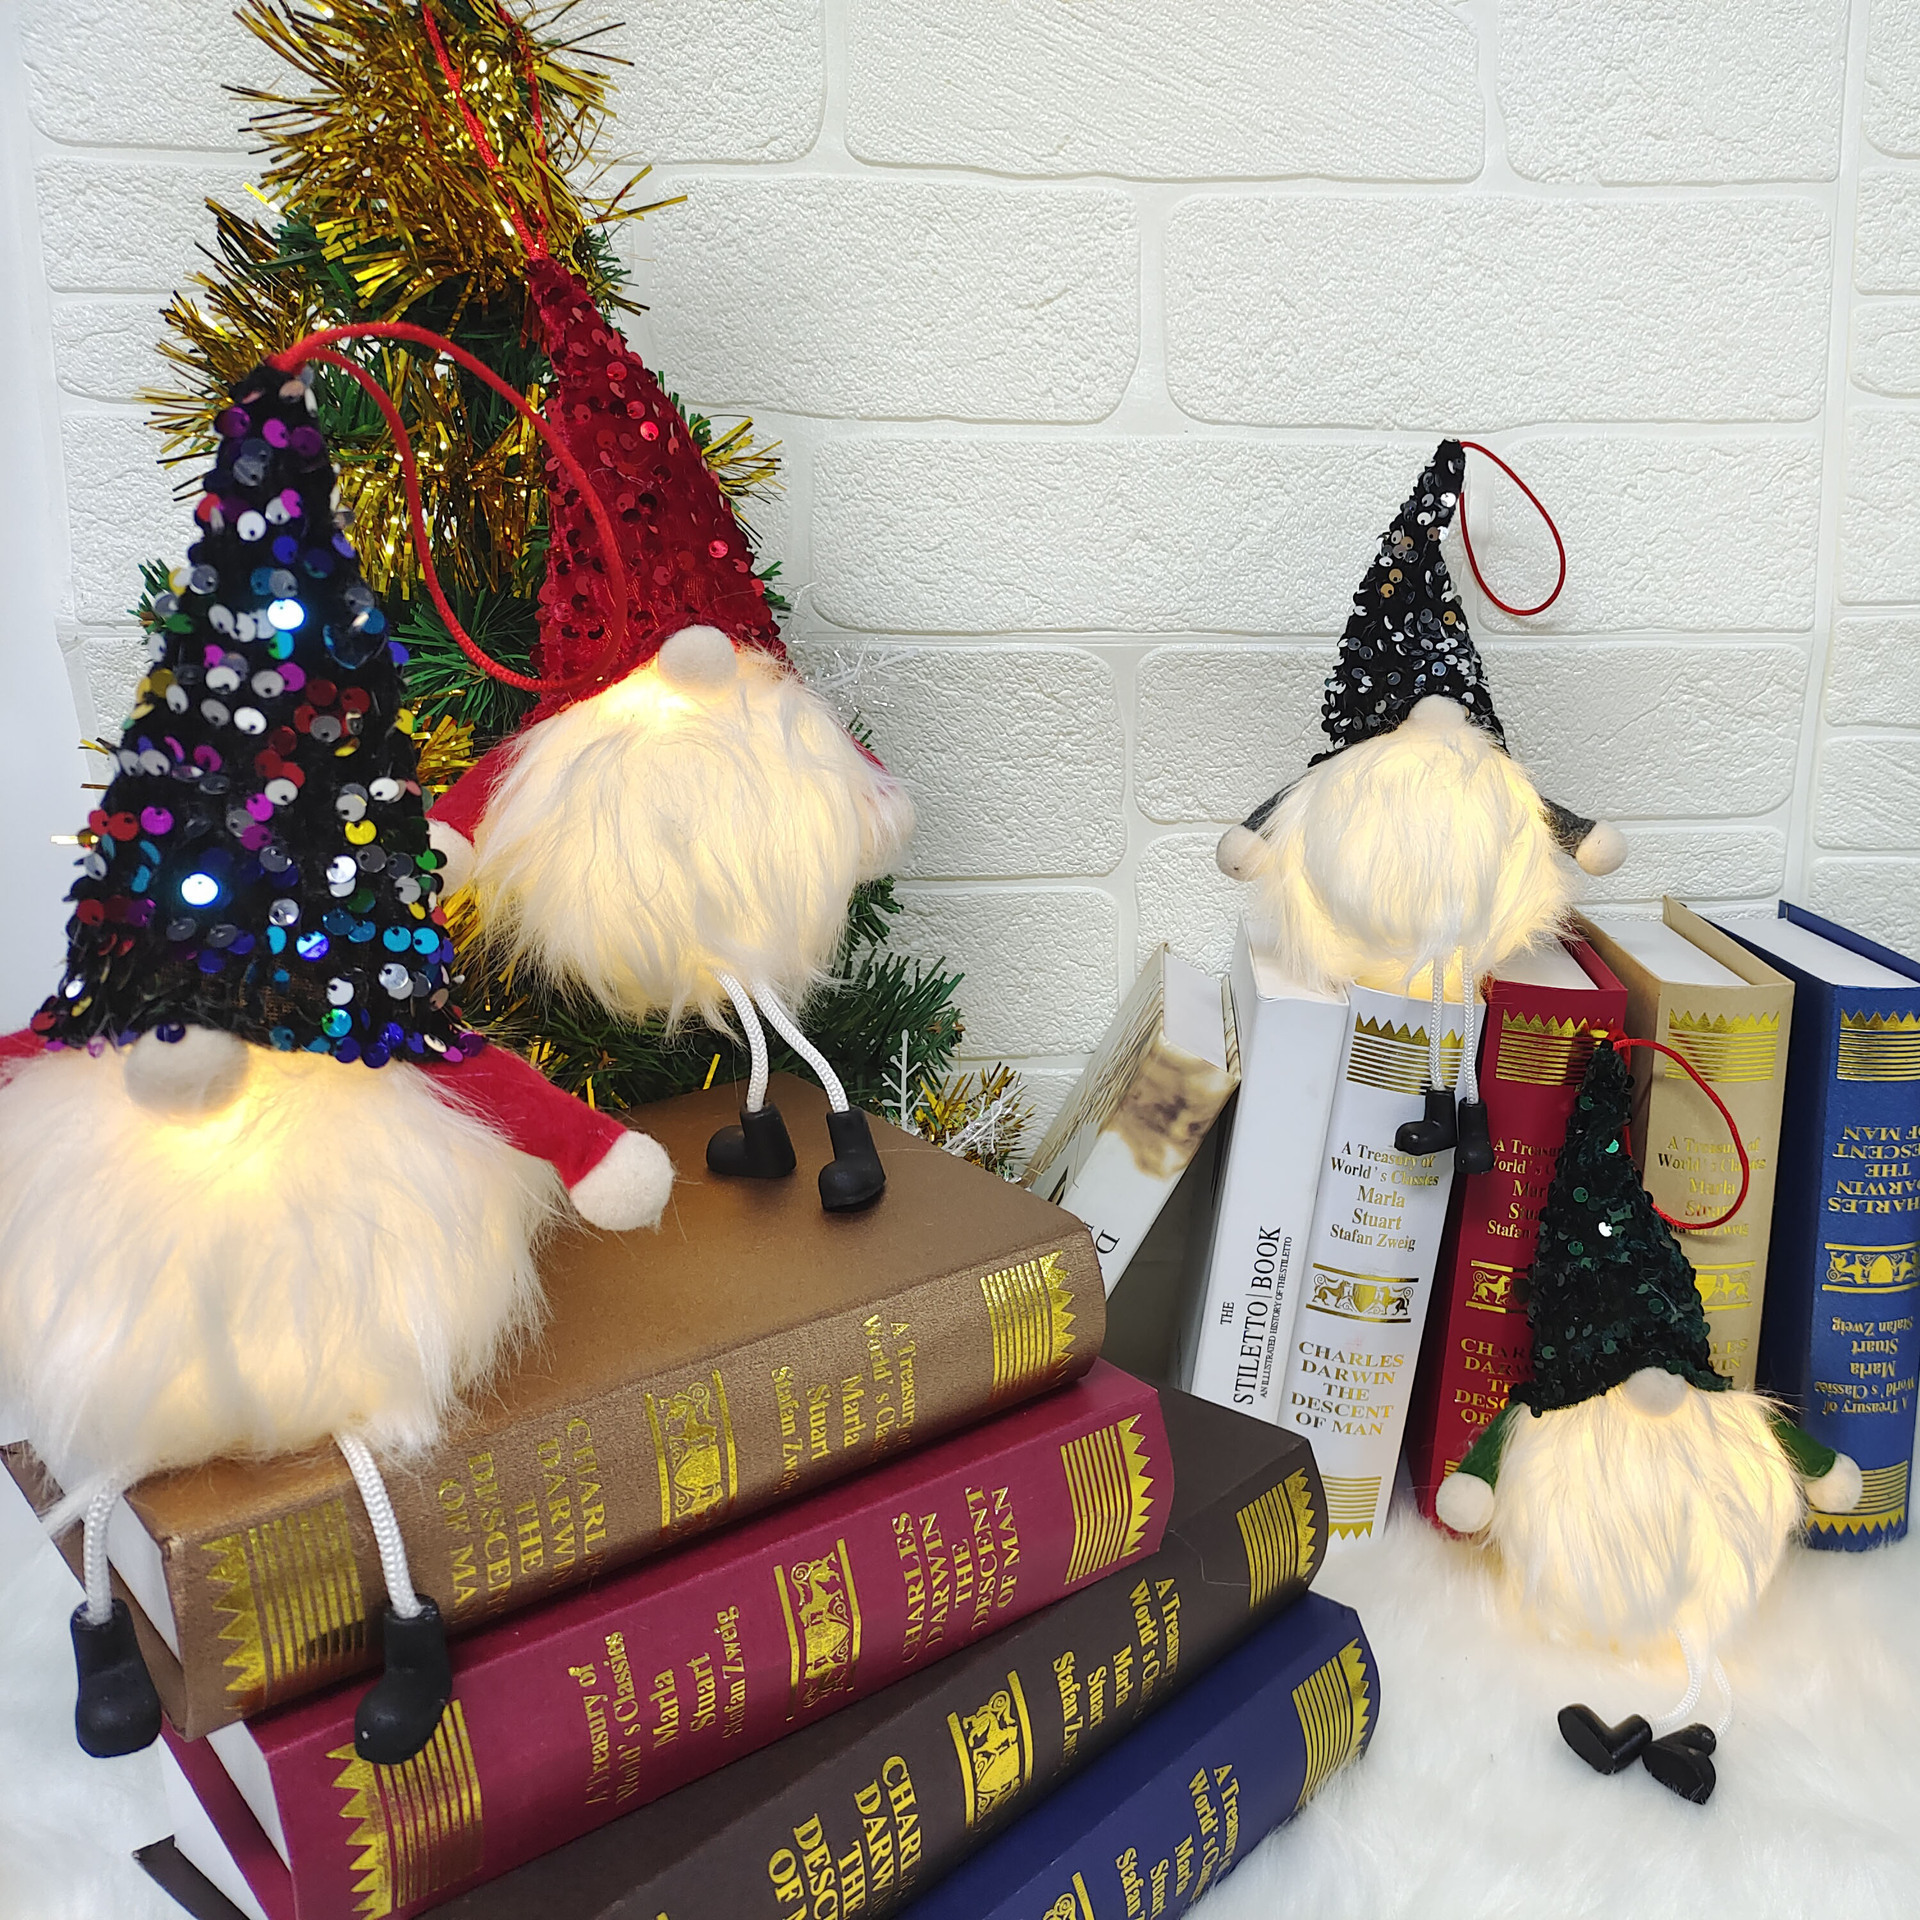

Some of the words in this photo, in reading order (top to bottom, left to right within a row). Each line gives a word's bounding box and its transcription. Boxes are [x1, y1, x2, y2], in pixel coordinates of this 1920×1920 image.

[1493, 1137, 1506, 1152] A
[1667, 1136, 1679, 1151] A
[1747, 1137, 1761, 1152] of
[1842, 1125, 1901, 1141] MAN
[1341, 1141, 1352, 1155] A
[1357, 1143, 1418, 1171] Treasury
[1421, 1154, 1436, 1168] of
[1832, 1142, 1920, 1160] ESCENT
[1864, 1162, 1912, 1178] THE
[1357, 1185, 1405, 1208] Marla
[1512, 1179, 1547, 1198] Mar
[1689, 1177, 1737, 1195] Marla
[1352, 1207, 1402, 1230] Stuart
[1827, 1196, 1920, 1214] HARLES
[1330, 1224, 1373, 1246] Stafan
[1376, 1233, 1416, 1252] Zweig
[1220, 1302, 1234, 1325] THE
[1233, 1301, 1268, 1405] STILETTO
[1251, 1226, 1281, 1290] BOOK
[1270, 1301, 1282, 1334] HISTORY
[1832, 1316, 1876, 1337] Zweig
[1878, 1316, 1913, 1335] Stafan
[890, 1322, 911, 1339] A
[1298, 1341, 1405, 1368] CHARLES
[1460, 1338, 1526, 1359] CHAR
[1851, 1338, 1899, 1355] Stuart
[1301, 1359, 1396, 1385] DARWIN
[1850, 1360, 1896, 1379] Marla
[896, 1340, 917, 1430] Treasury
[1323, 1382, 1370, 1401] THE
[1454, 1388, 1509, 1410] DESC
[771, 1365, 800, 1437] Stafan
[840, 1373, 867, 1448] Marla
[1291, 1391, 1394, 1419] DESCENT
[1822, 1400, 1838, 1416] of
[1841, 1399, 1900, 1414] Treasury
[1901, 1395, 1909, 1410] A
[806, 1384, 833, 1461] Stuart
[1295, 1411, 1327, 1429] OF
[1332, 1420, 1384, 1436] MAN
[1460, 1408, 1493, 1426] OF
[438, 1478, 471, 1534] OF
[514, 1492, 544, 1575] THE
[991, 1486, 1020, 1571] MAN
[965, 1485, 999, 1631] DESCENT
[892, 1512, 926, 1663] CHARLES
[919, 1512, 950, 1649] DARWIN
[951, 1538, 974, 1609] THE
[997, 1574, 1017, 1609] OF
[1155, 1578, 1175, 1600] A
[713, 1605, 745, 1680] Zweig
[567, 1663, 597, 1688] of
[1052, 1651, 1082, 1723] Stafan
[1113, 1644, 1135, 1709] Marla
[686, 1652, 717, 1733] Stuart
[1087, 1665, 1108, 1730] Stuart
[650, 1668, 680, 1750] Marla
[721, 1678, 746, 1739] Stafan
[1213, 1764, 1233, 1787] A
[1219, 1777, 1240, 1863] Treasury
[768, 1848, 804, 1904] OF
[837, 1839, 866, 1919] THE
[1174, 1834, 1195, 1897] Marla
[1115, 1847, 1145, 1918] Stafan
[1150, 1858, 1170, 1920] Stuart
